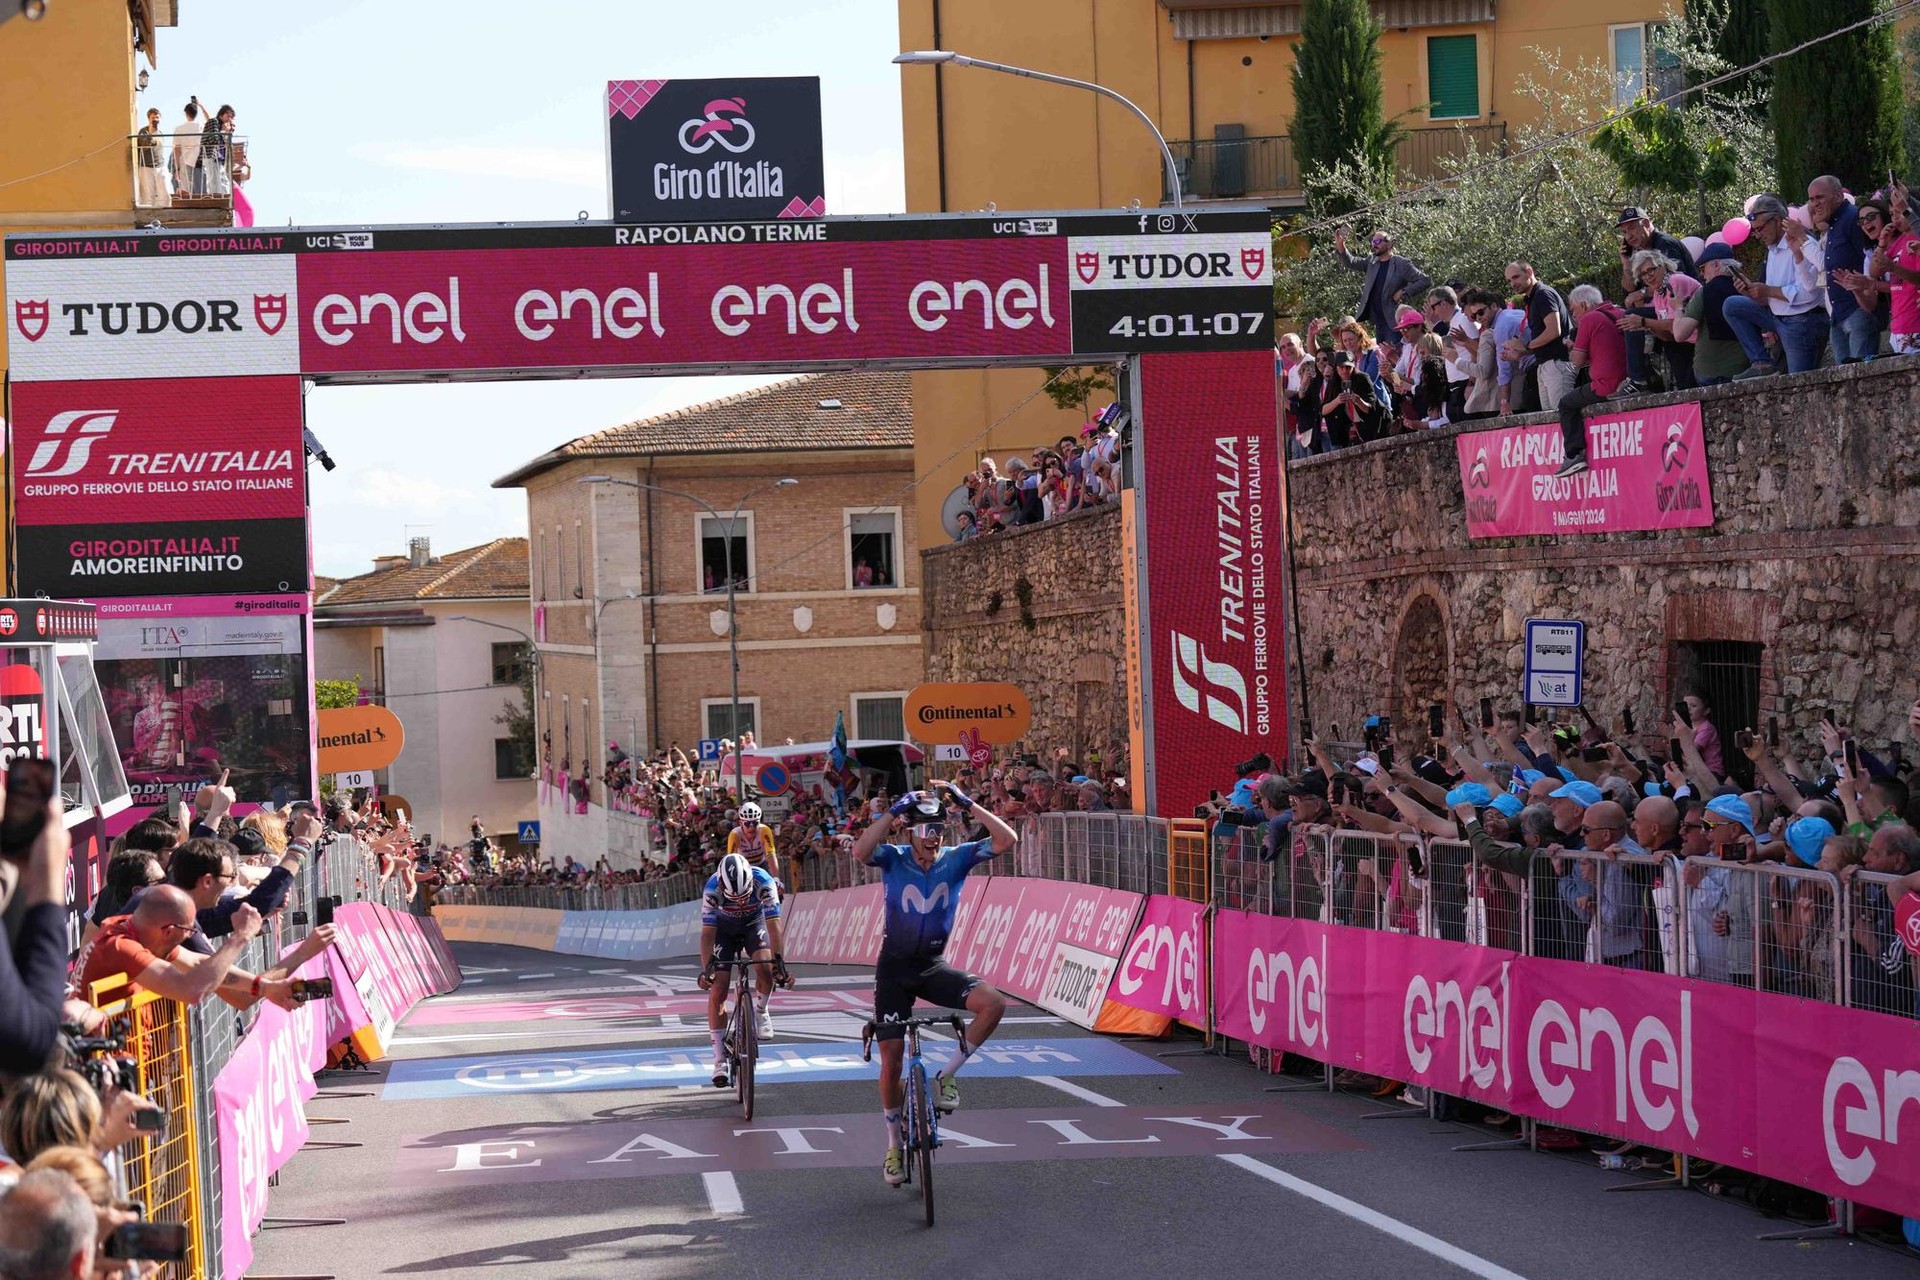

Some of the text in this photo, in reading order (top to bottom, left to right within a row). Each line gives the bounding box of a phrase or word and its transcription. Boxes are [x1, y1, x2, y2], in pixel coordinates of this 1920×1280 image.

[654, 160, 783, 200] Giro d'Italia
[615, 224, 827, 244] RAPOLANO TERME
[993, 222, 1016, 234] UCI
[14, 237, 283, 256] GIRODITALIA.IT GIRODITALIA.IT
[306, 236, 330, 248] UCI
[1108, 252, 1233, 279] TUDOR
[514, 272, 665, 341] enel
[711, 268, 860, 336] enel
[909, 263, 1055, 332] enel
[62, 300, 242, 336] TUDOR
[313, 276, 466, 346] enel
[1109, 312, 1264, 337] 4:01:07
[1590, 419, 1643, 460] TERME
[108, 450, 293, 475] TRENITALIA
[24, 477, 293, 496] GRUPPO FERROVIE DELLO STATO ITALIANE
[69, 536, 241, 558] GIRODITALIA.IT
[1216, 436, 1245, 642] TRENITALIA
[70, 554, 243, 576] AMOREINFINITO
[1247, 435, 1269, 736] GRUPPO FERROVIE DELLO STATO ITALIANE
[101, 603, 172, 613] GIRODITALIA.IT
[234, 600, 300, 611] #giroditalia
[141, 627, 180, 645] ITA
[225, 631, 284, 640] madeinitaly.gov.it
[1554, 683, 1567, 692] at
[0, 703, 42, 743] RTL
[918, 704, 1003, 724] Continental
[702, 741, 716, 759] P
[947, 747, 961, 758] 10
[346, 774, 361, 785] 10
[1065, 891, 1136, 951] enel enel
[1119, 912, 1200, 1012] enel
[1053, 959, 1097, 1009] TUDOR
[1248, 934, 1329, 1050] enel
[1403, 960, 1512, 1093] enel
[1527, 990, 1700, 1140] enel
[1822, 1056, 1920, 1186] en
